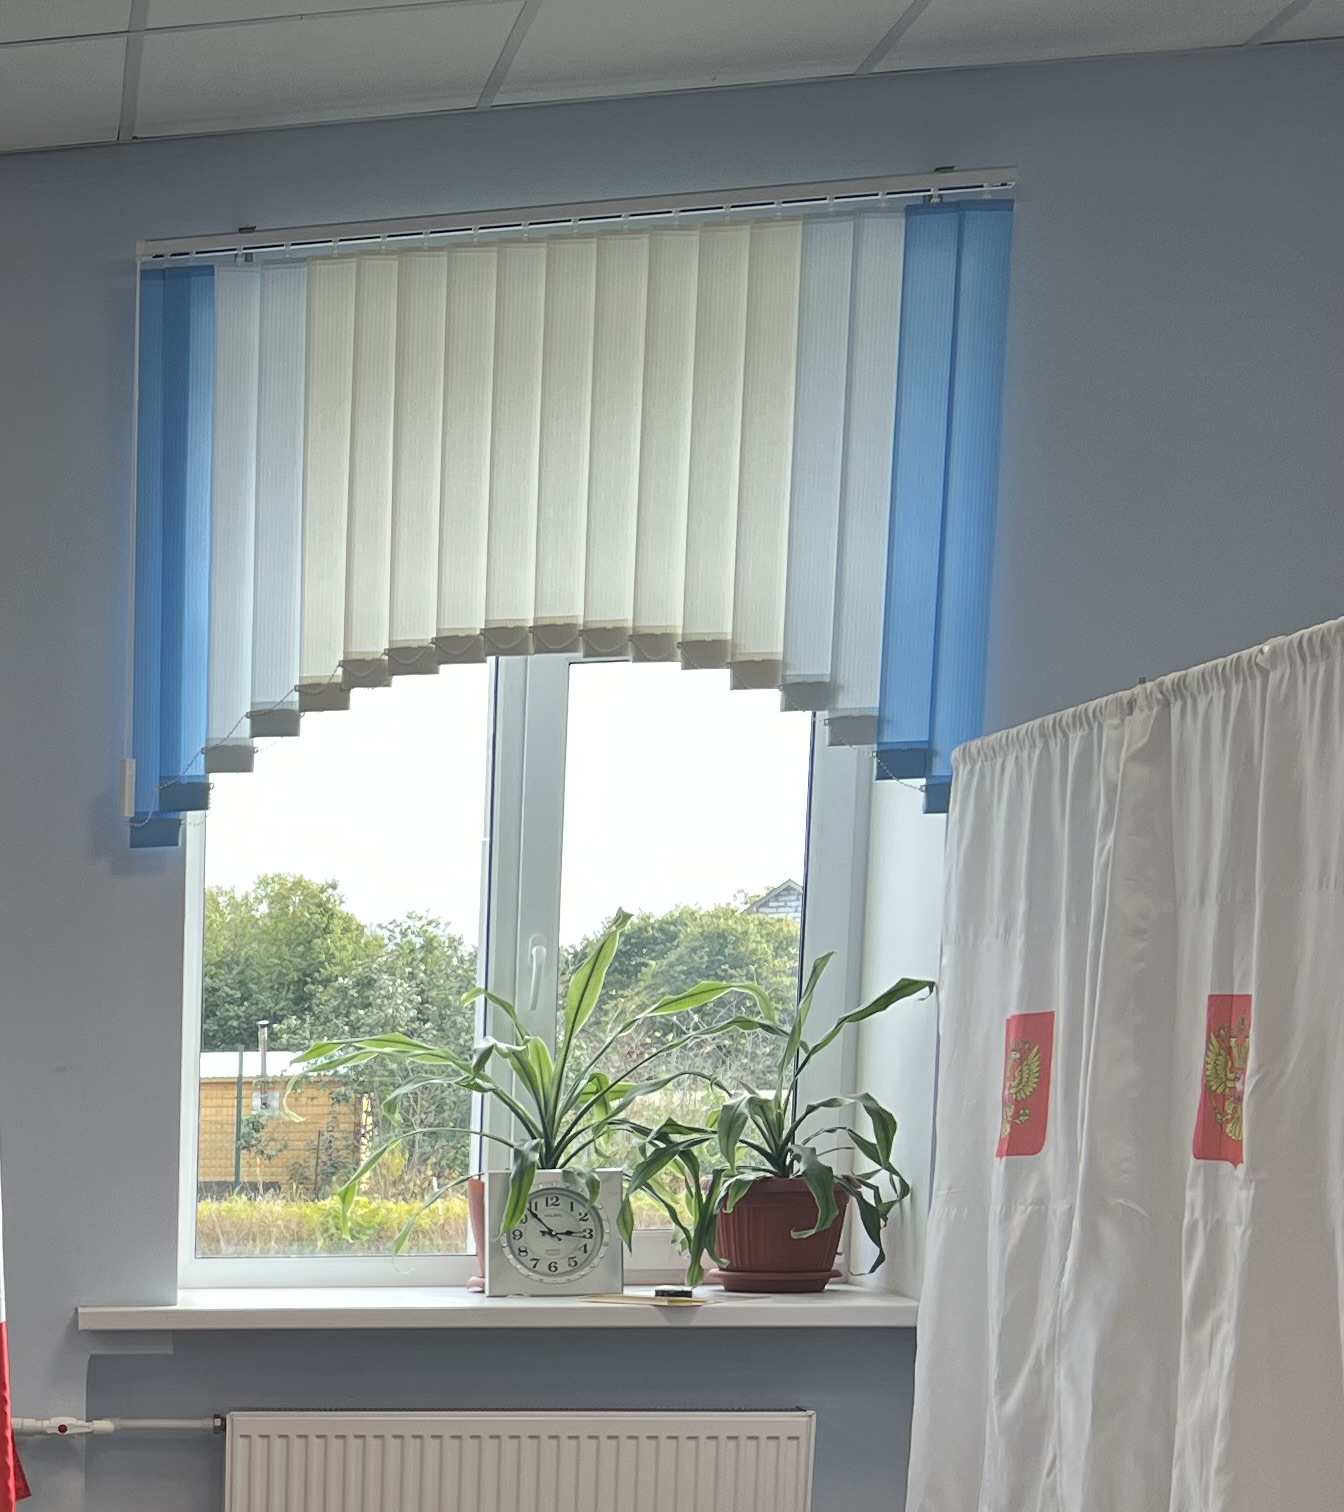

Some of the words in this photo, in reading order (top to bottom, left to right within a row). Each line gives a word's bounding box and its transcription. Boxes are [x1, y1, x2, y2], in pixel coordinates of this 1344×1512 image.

[545, 1195, 560, 1207] 12
[569, 1201, 574, 1212] 1
[578, 1212, 589, 1222] 2
[512, 1229, 523, 1241] 9
[582, 1228, 594, 1239] 3
[518, 1246, 529, 1257] 8
[577, 1243, 588, 1254] 4
[530, 1258, 540, 1269] 7
[548, 1261, 558, 1273] 6
[567, 1256, 578, 1267] 5
